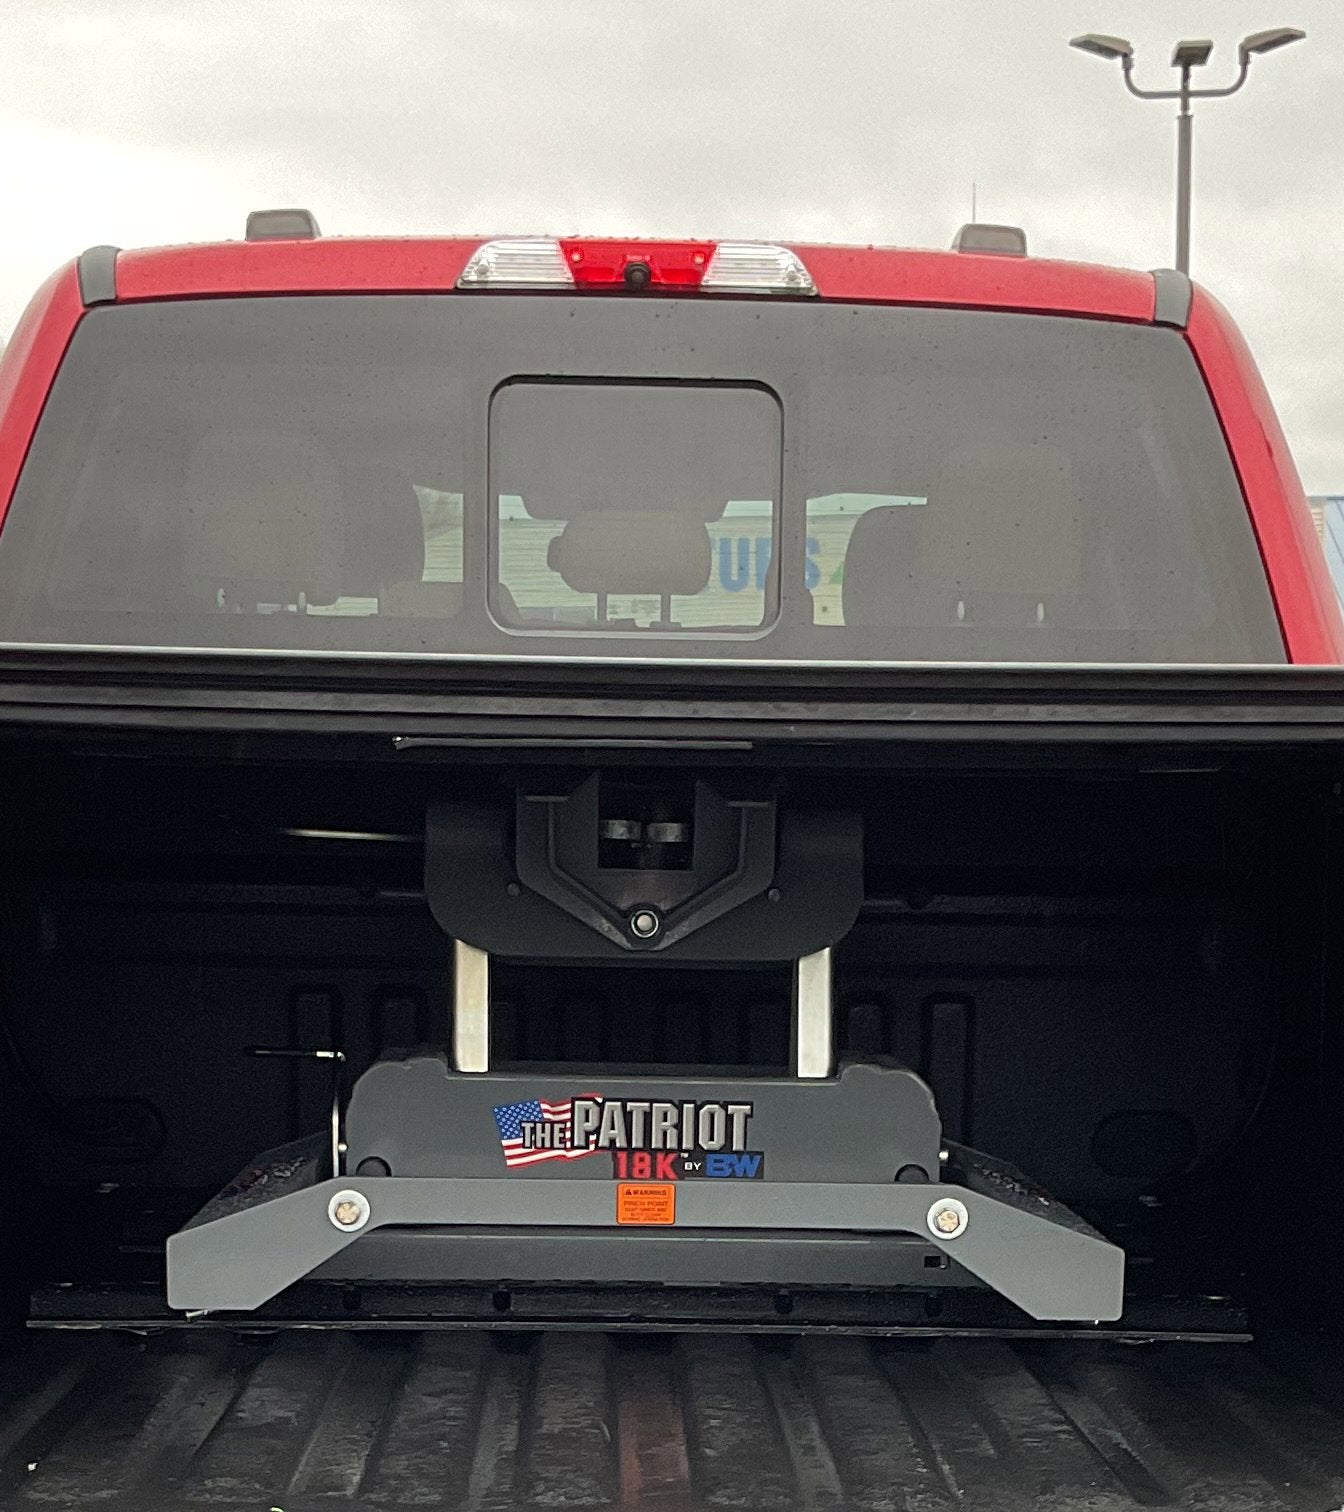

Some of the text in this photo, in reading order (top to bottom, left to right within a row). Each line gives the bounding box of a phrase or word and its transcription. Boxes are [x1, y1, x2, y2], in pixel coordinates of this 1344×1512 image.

[521, 1100, 752, 1151] THE PATRIOT
[616, 1151, 679, 1180] 18K
[684, 1161, 702, 1171] BY
